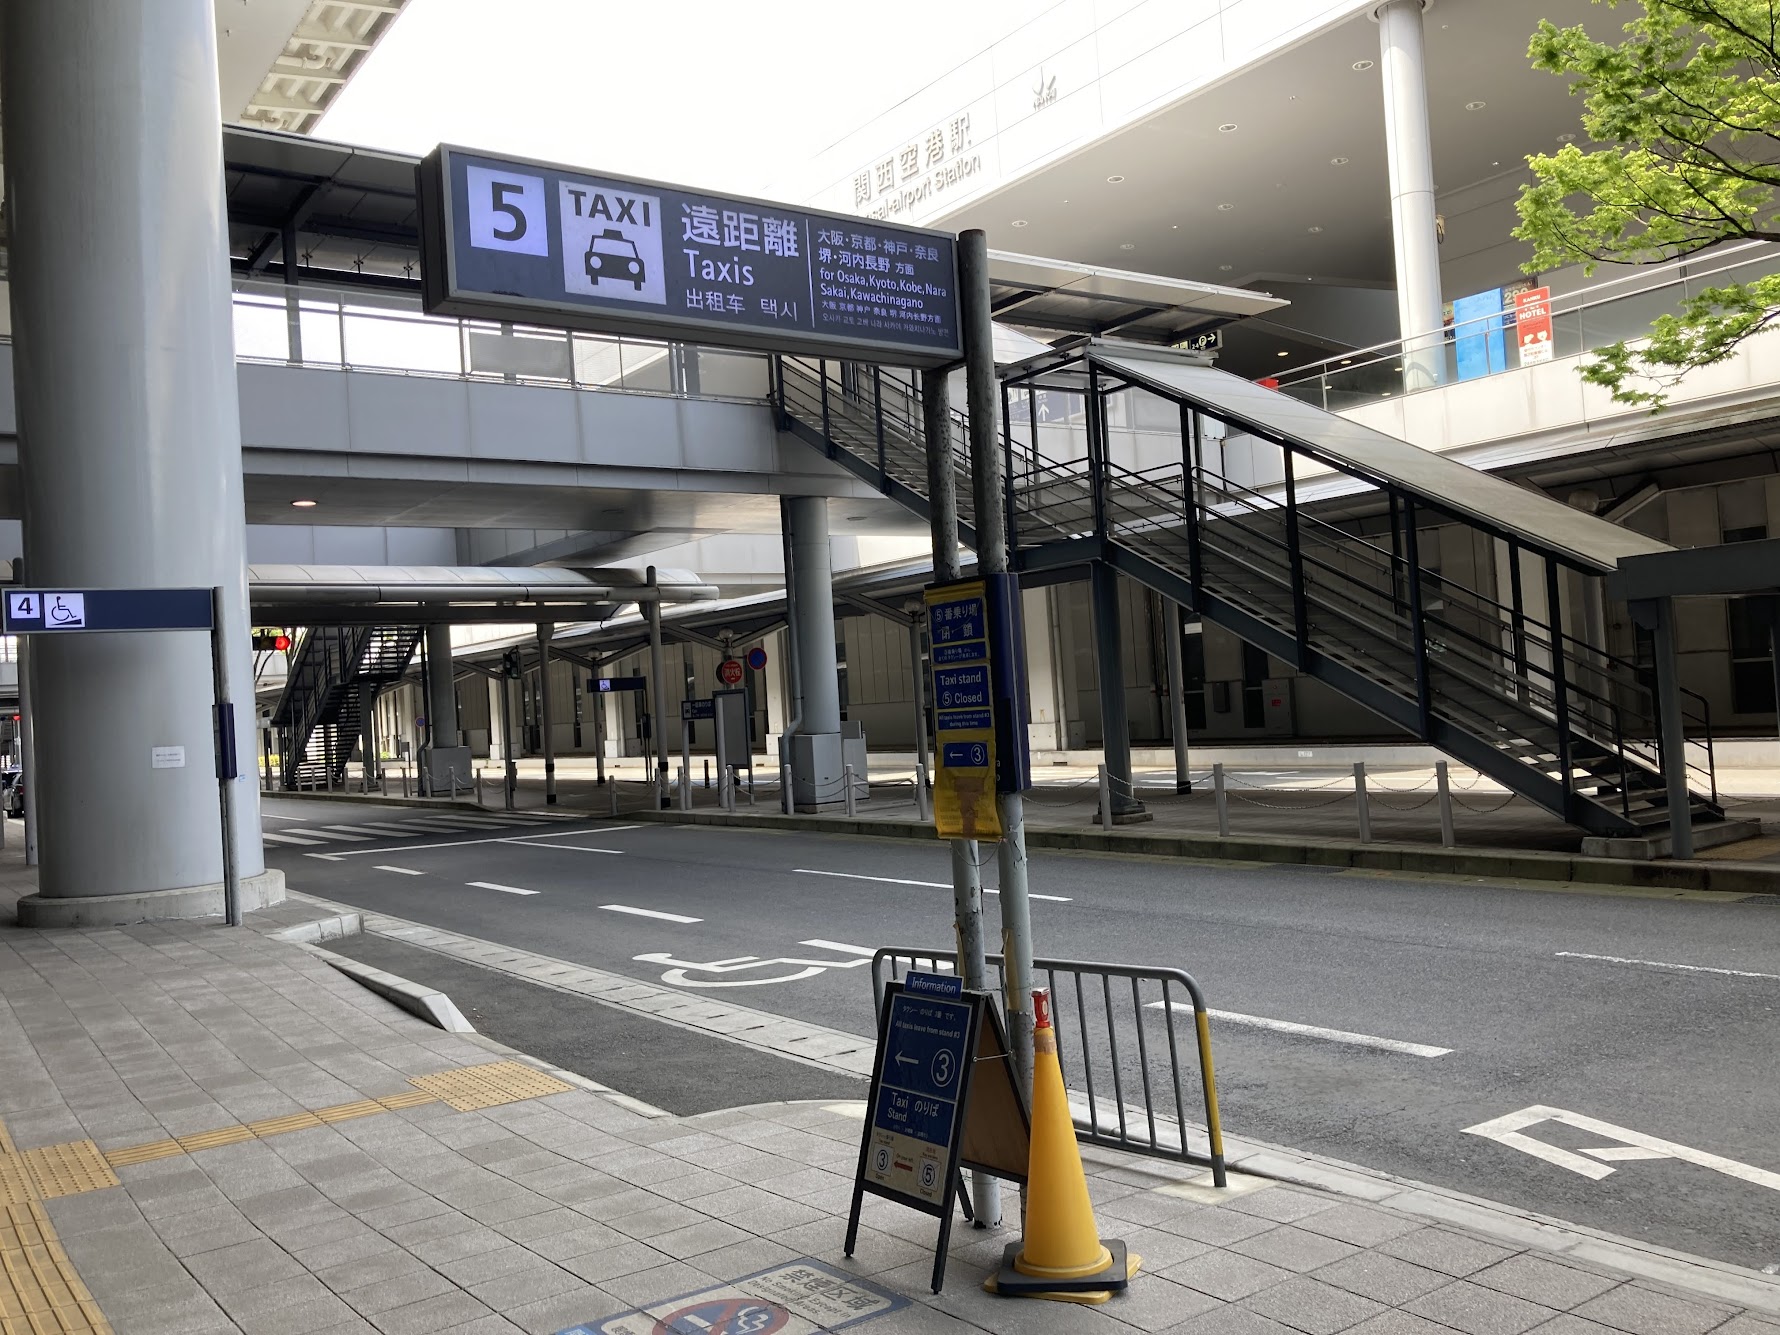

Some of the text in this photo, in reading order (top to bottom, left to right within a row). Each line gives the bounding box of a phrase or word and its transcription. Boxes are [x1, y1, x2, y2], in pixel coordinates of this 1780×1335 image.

[853, 112, 971, 208] 関西空港駅
[935, 155, 981, 191] Station
[491, 181, 527, 242] 5
[567, 189, 651, 228] TAXI
[681, 203, 800, 258] 遠距離
[683, 248, 755, 286] Taxis
[819, 267, 835, 281] for
[895, 262, 915, 276] 方面
[686, 288, 746, 315] 出租车
[760, 298, 798, 322] 택시
[1519, 307, 1547, 320] HOTEL
[17, 597, 33, 615] 4
[939, 670, 982, 686] Taxi stand
[954, 691, 983, 704] Closed
[911, 976, 956, 995] Information
[926, 1026, 939, 1035] from
[939, 1028, 954, 1038] stand
[887, 1107, 908, 1123] Stand
[891, 1091, 940, 1118] Taxi のりば
[778, 1269, 881, 1311] 禁煙区域
